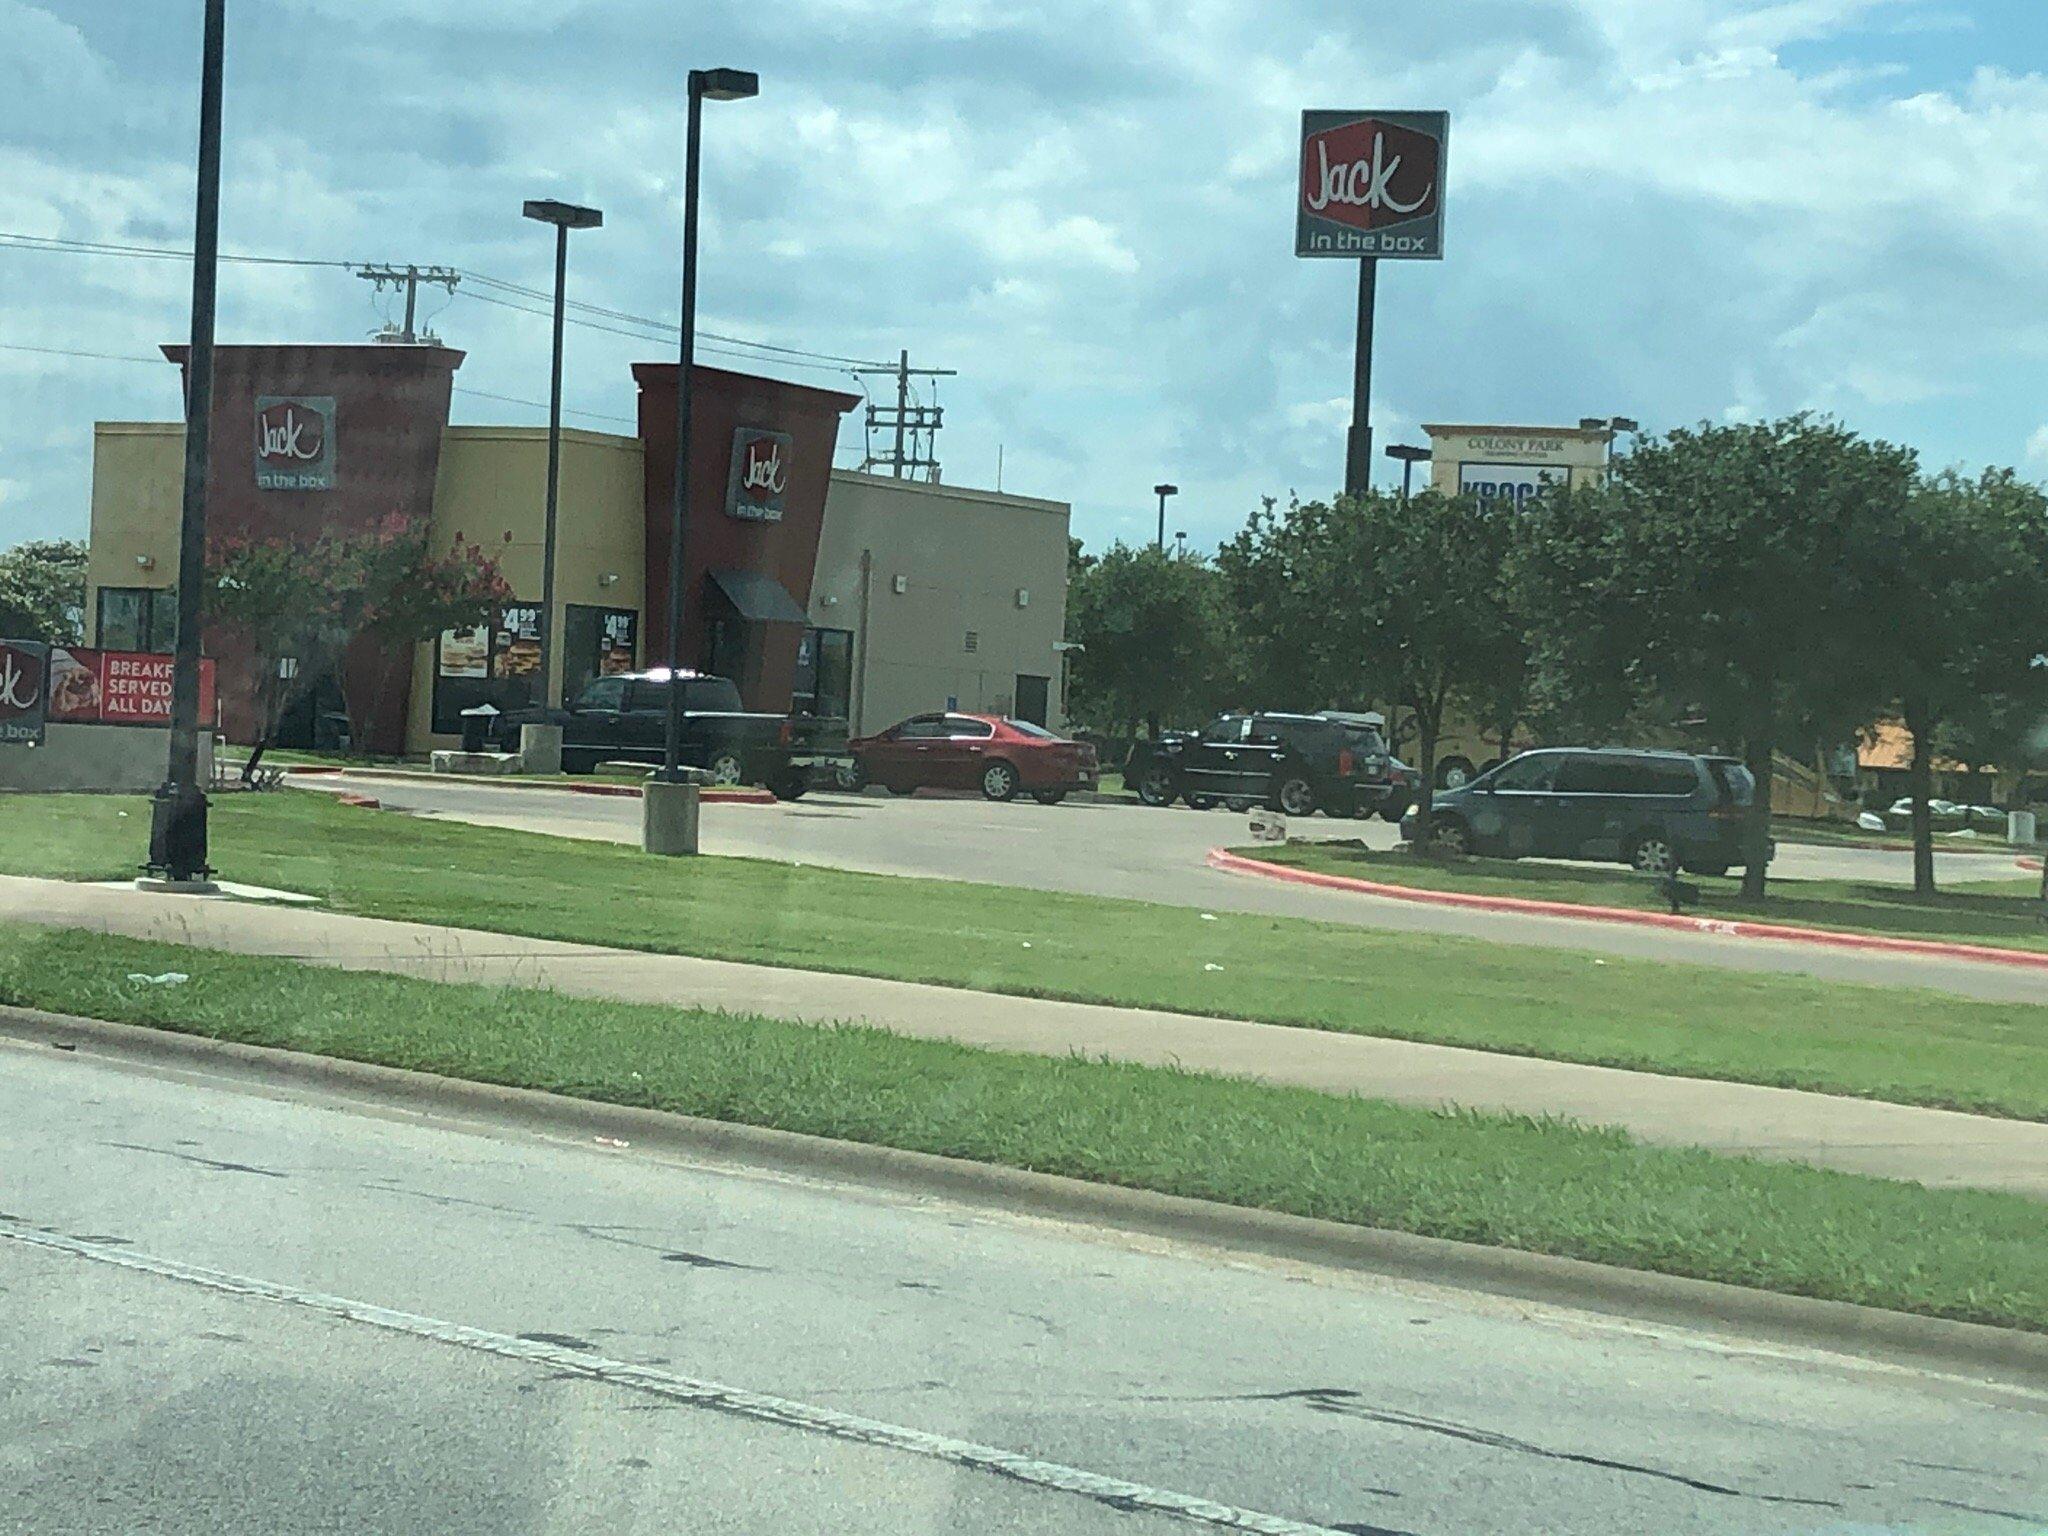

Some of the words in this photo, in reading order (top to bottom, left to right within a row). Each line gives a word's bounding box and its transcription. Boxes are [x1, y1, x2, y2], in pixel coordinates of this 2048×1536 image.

[1308, 132, 1432, 213] Jack
[1310, 232, 1332, 249] in
[1337, 231, 1375, 250] the
[1382, 234, 1426, 251] box
[259, 408, 321, 459] Jack
[1468, 437, 1526, 451] COLONY
[1527, 438, 1564, 451] PARK
[743, 444, 786, 493] Jack
[258, 475, 271, 487] in
[274, 474, 297, 488] the
[299, 475, 326, 488] box
[109, 679, 173, 696] SERVED
[108, 697, 137, 713] ALL
[141, 699, 173, 714] DAY
[7, 724, 39, 739] box
